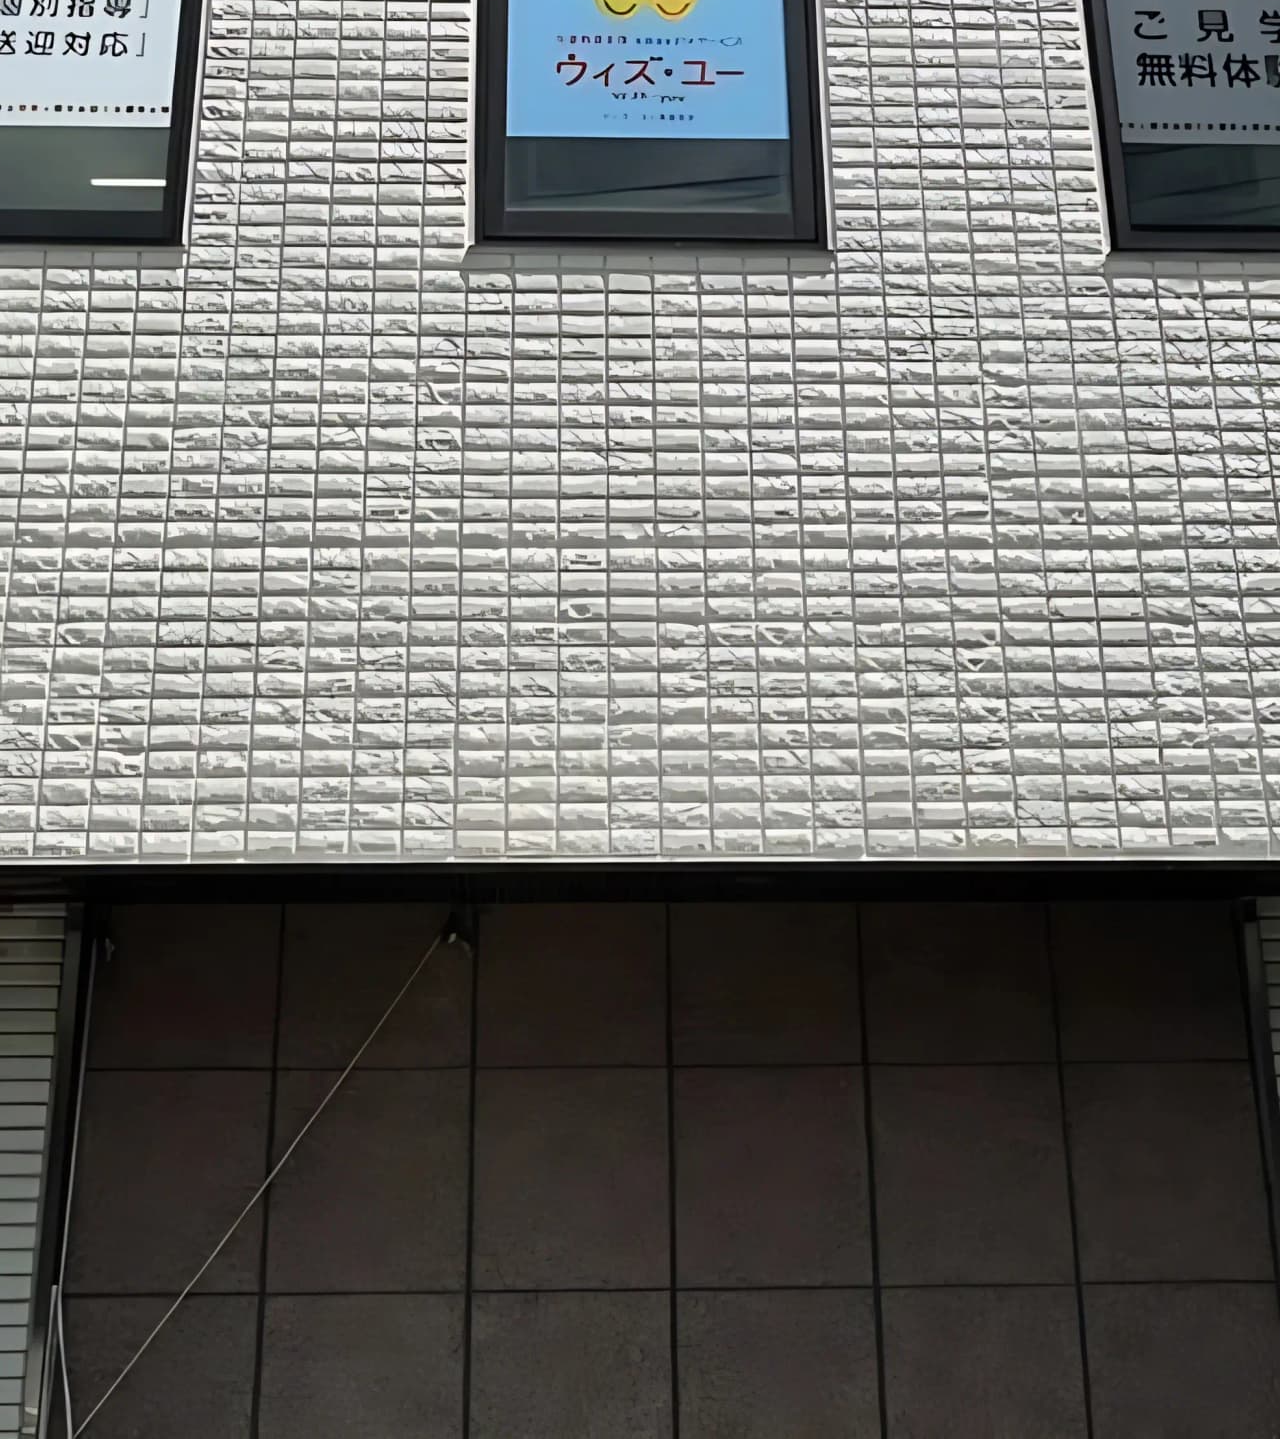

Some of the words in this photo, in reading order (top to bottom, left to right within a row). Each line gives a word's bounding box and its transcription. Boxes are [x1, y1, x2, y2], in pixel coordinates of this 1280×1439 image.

[556, 53, 745, 87] ウィズ・ユー
